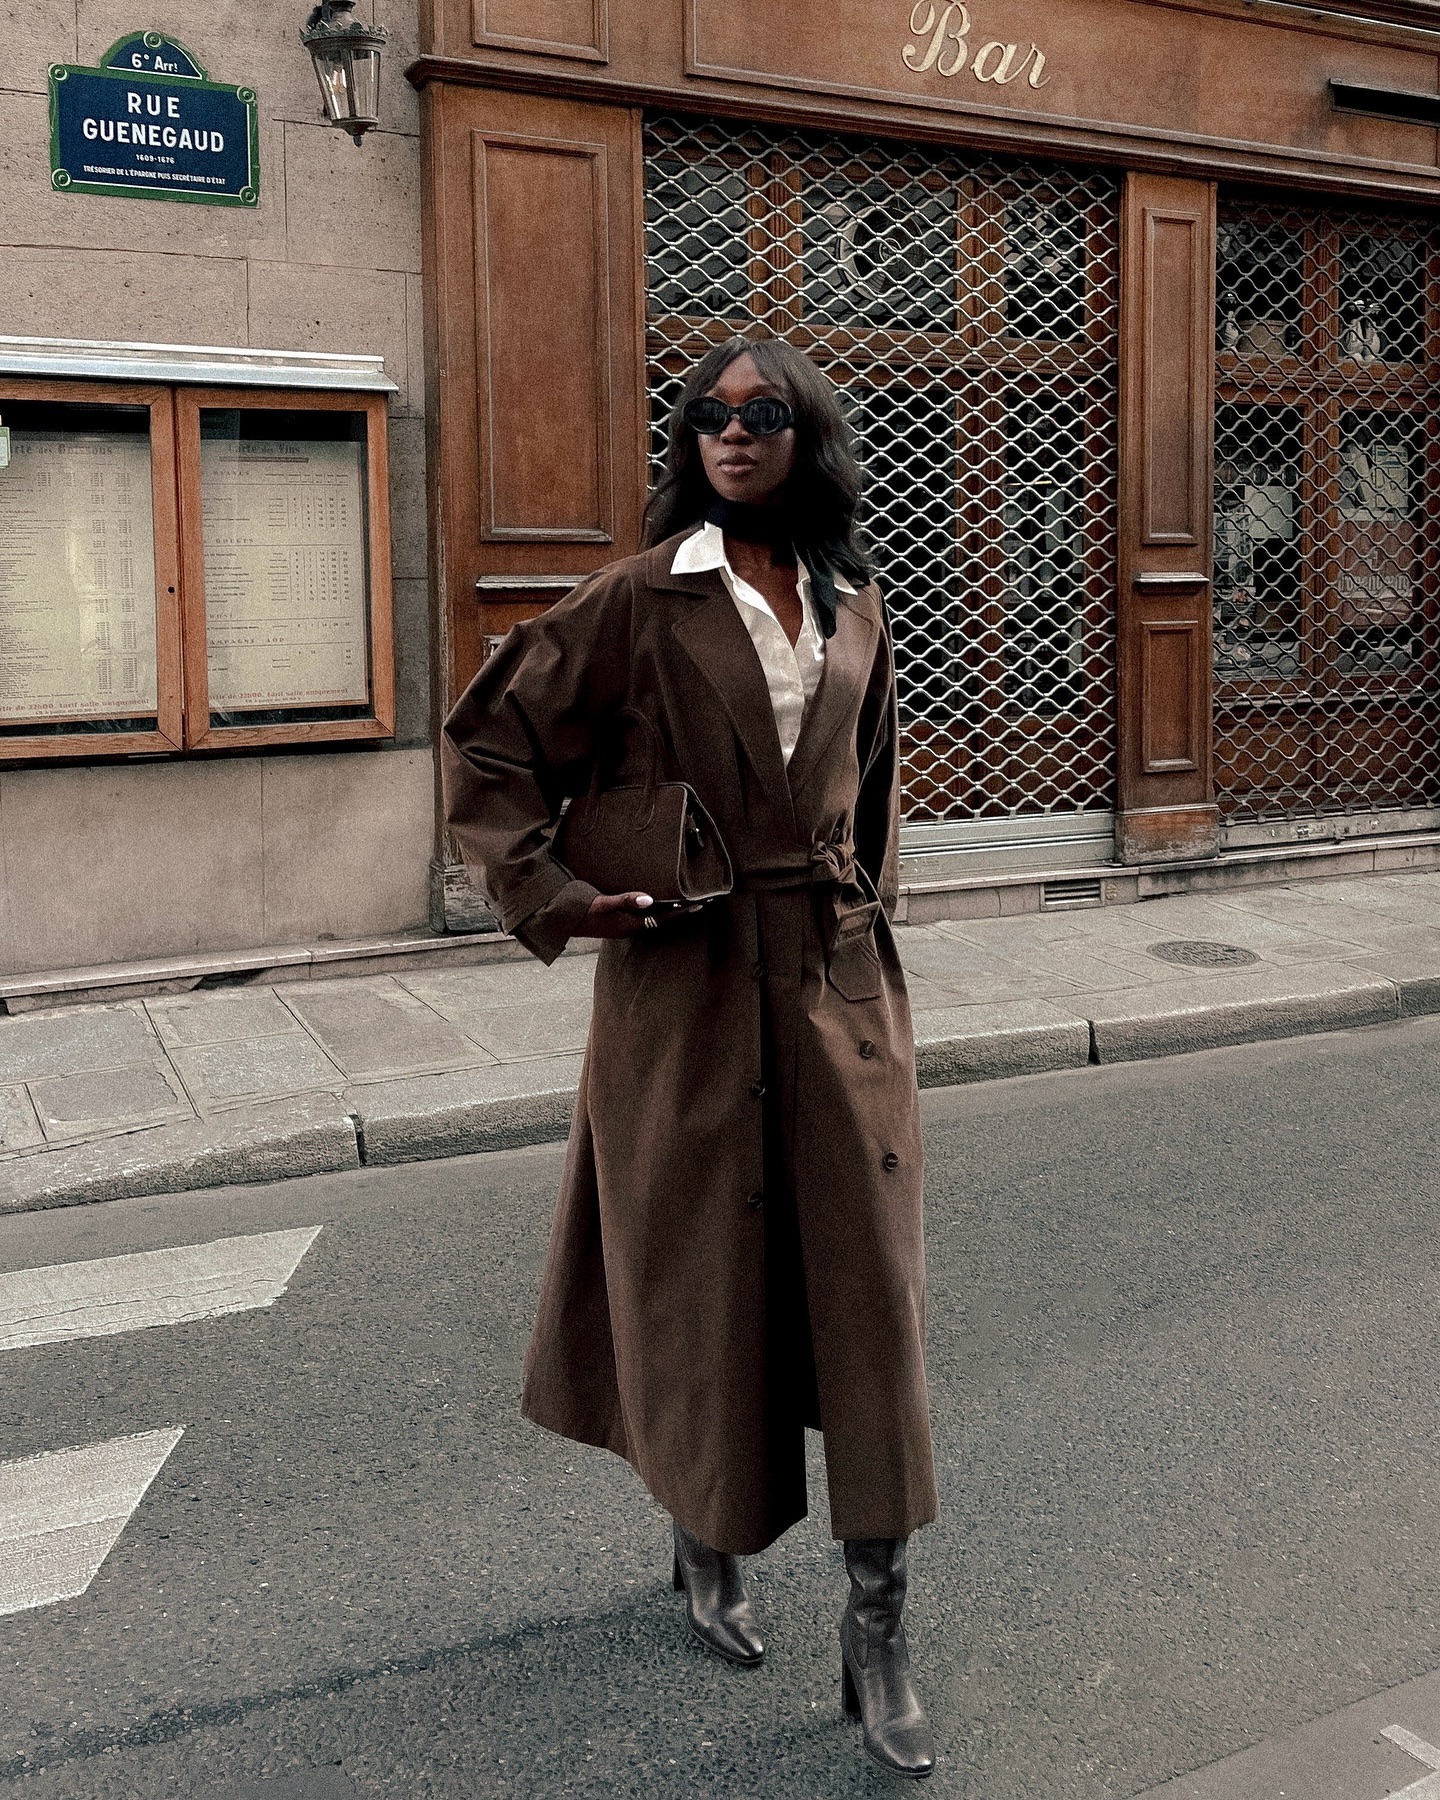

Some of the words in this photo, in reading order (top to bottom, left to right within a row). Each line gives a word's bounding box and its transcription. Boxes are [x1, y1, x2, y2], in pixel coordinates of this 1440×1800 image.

[902, 0, 1051, 89] Bar
[127, 92, 180, 118] RUE
[82, 118, 224, 152] GUENEGAUD
[116, 168, 125, 176] DE
[157, 172, 171, 180] PUIS
